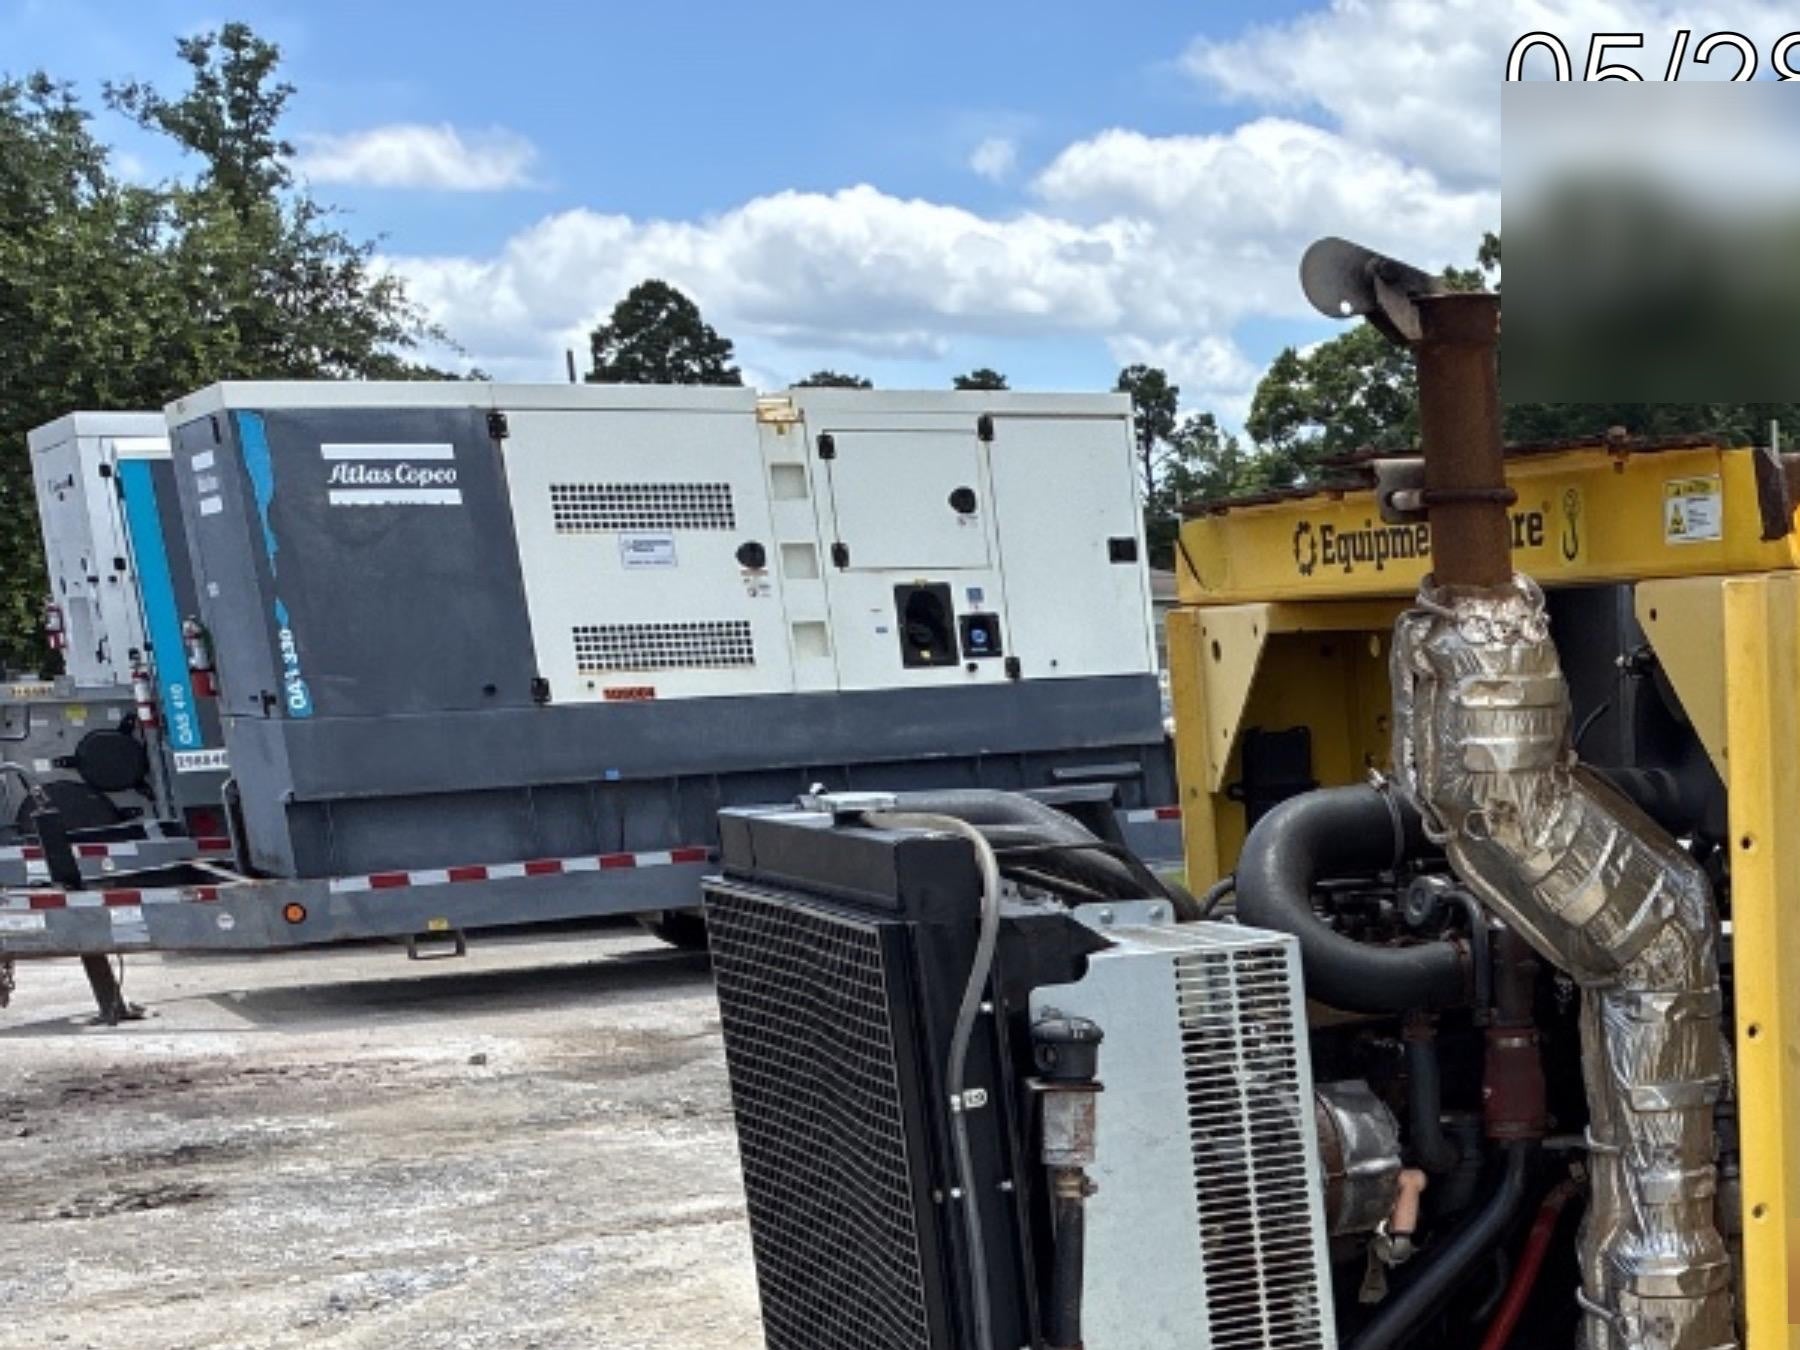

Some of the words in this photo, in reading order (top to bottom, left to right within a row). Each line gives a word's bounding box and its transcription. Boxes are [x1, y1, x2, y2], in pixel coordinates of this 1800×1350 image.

[327, 462, 392, 484] Atlas
[395, 462, 457, 487] Copco
[1320, 510, 1544, 574] Equipmere
